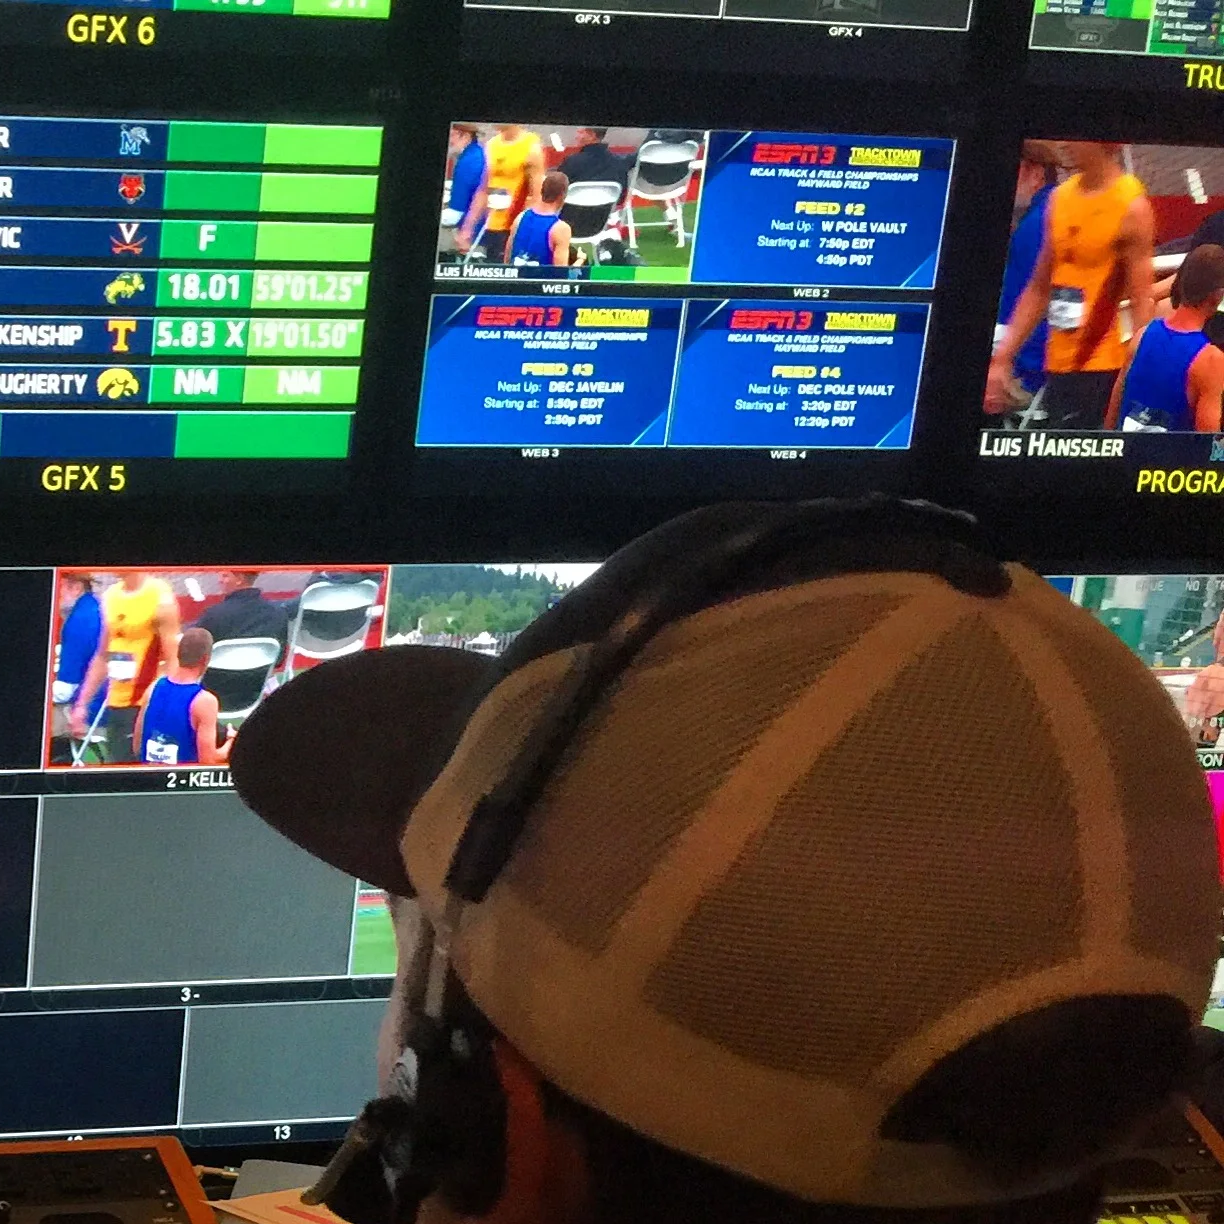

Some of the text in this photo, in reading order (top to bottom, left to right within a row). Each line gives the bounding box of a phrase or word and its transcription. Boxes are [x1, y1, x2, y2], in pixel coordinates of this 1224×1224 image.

[575, 13, 611, 25] GFX 3
[68, 14, 155, 45] GFX 6
[829, 26, 863, 38] GFX 4
[850, 147, 921, 160] TRACKTOWN
[750, 168, 775, 177] NCAA
[777, 168, 807, 178] TRACK
[817, 170, 843, 179] FIELD
[845, 171, 919, 182] CHAMPIONSHIPS
[798, 179, 869, 189] HAYWARD FIELD
[795, 201, 865, 216] FEED #2
[771, 220, 907, 234] Next Up: W POLE VAULT
[199, 224, 217, 251] F
[757, 236, 797, 249] Starting
[852, 238, 875, 250] EDT
[849, 254, 873, 266] PDT
[168, 273, 240, 300] 18.01
[542, 284, 580, 294] WEB 1
[793, 288, 830, 298] WEB 2
[156, 321, 246, 348] 5.83 X
[174, 369, 218, 395] NM
[277, 370, 321, 395] NM
[498, 381, 521, 392] Next
[549, 382, 574, 393] DEC
[576, 382, 624, 393] JAVELIN
[748, 384, 771, 394] Next
[798, 384, 822, 395] DEC
[824, 385, 854, 396] POLE
[857, 385, 895, 396] VAULT
[484, 398, 524, 411] Starting
[580, 398, 604, 409] EDT
[834, 401, 857, 412] EDT
[578, 414, 603, 425] PDT
[831, 416, 855, 427] PDT
[980, 432, 1124, 458] LUIS HANSSLER
[521, 449, 560, 458] WEB 3
[770, 451, 806, 459] WEB 4
[42, 465, 126, 491] GFX 5
[167, 772, 177, 788] 2
[181, 987, 191, 1002] 3
[273, 1125, 290, 1140] 13
